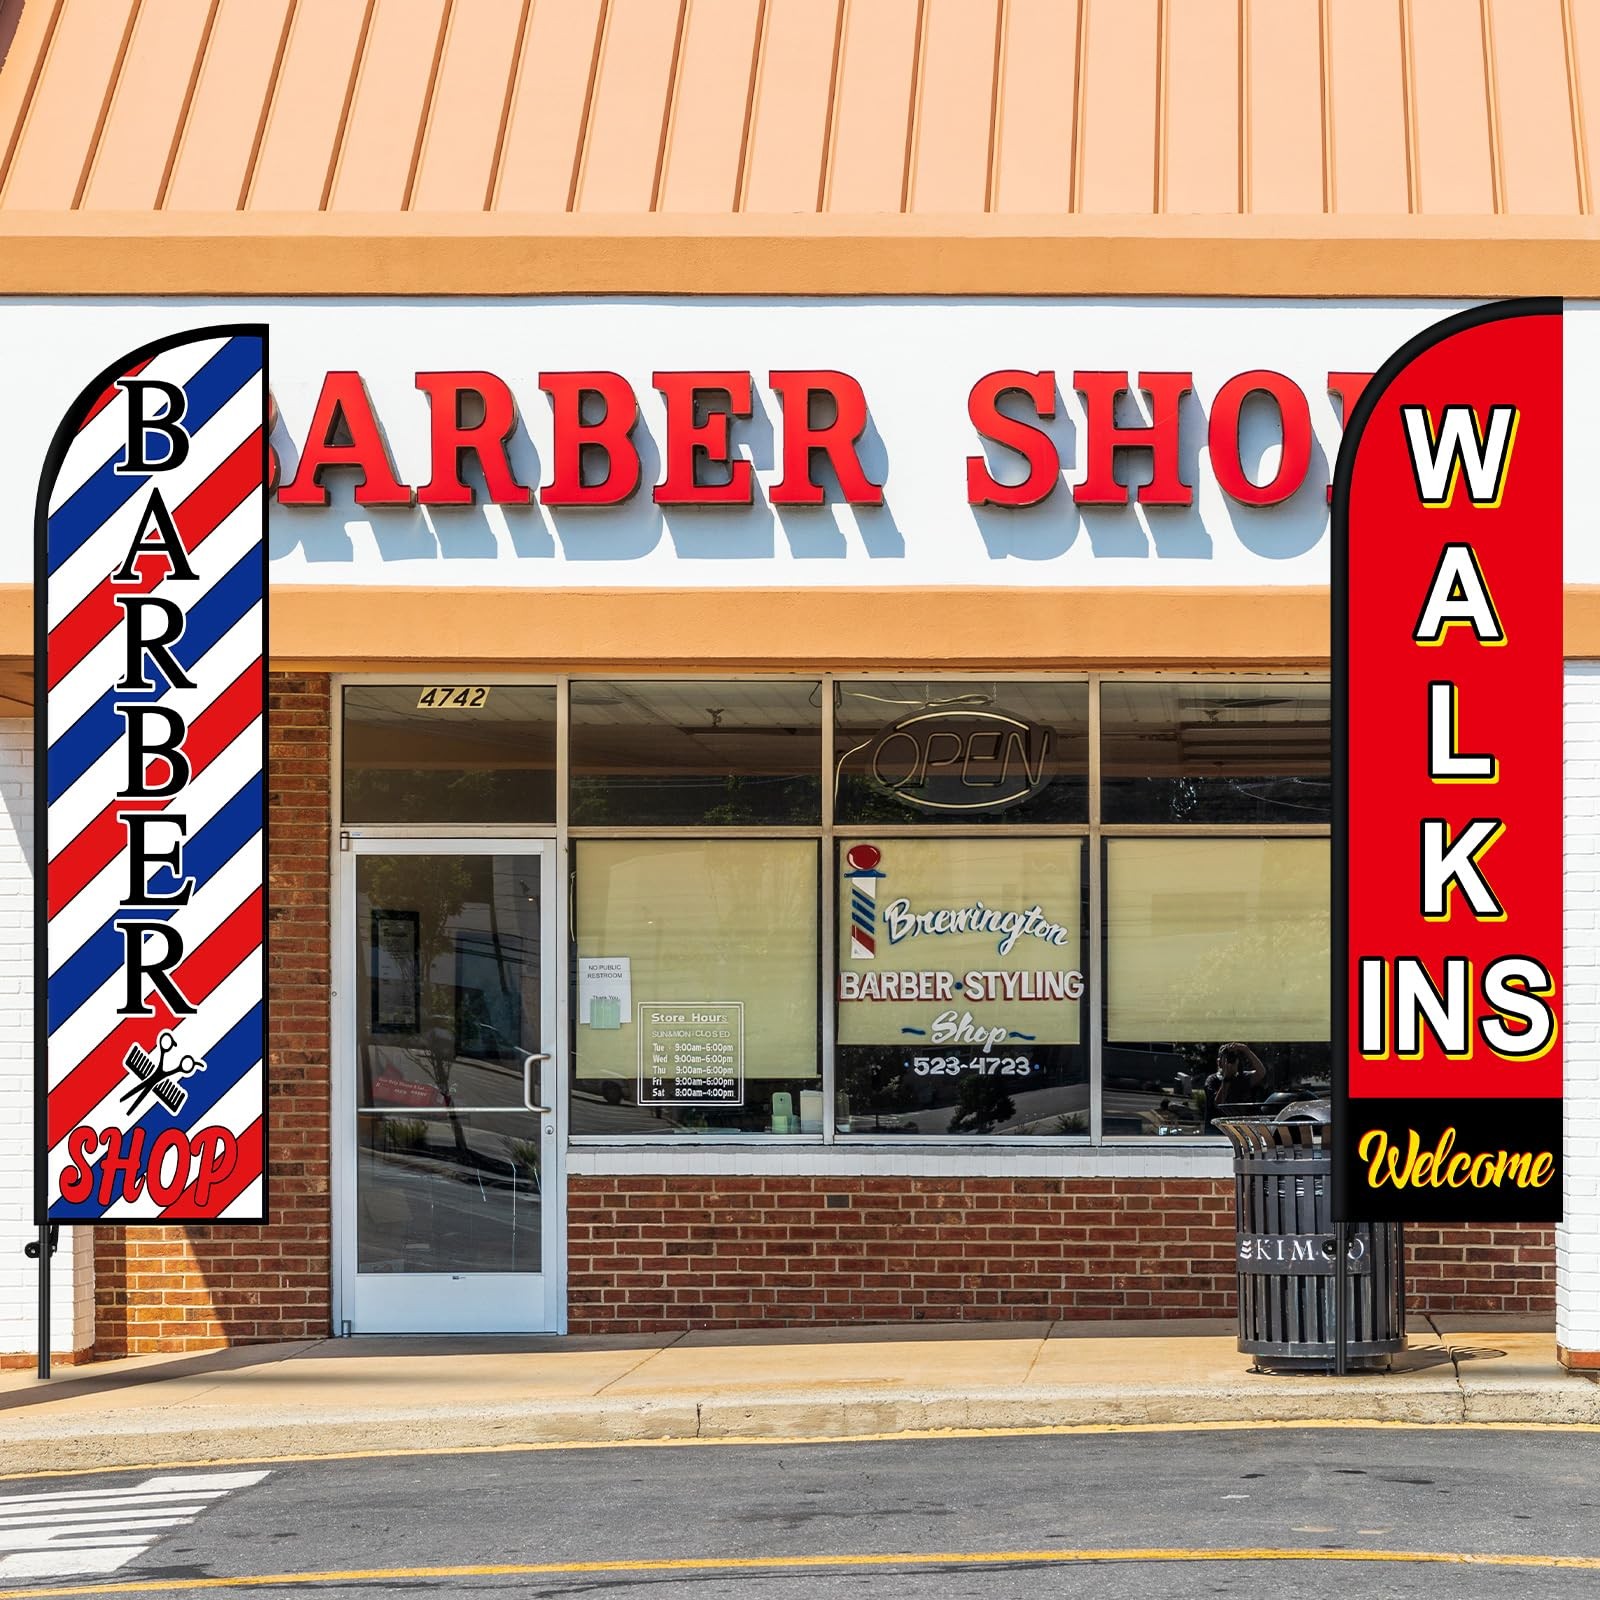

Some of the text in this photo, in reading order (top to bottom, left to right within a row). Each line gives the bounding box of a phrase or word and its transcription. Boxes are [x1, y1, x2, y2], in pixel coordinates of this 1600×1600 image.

[269, 370, 884, 507] ARBER
[1400, 404, 1521, 923] WALK
[112, 379, 199, 1014] BARBER
[420, 688, 486, 707] 4742
[872, 731, 1050, 789] OPEN
[883, 898, 1070, 956] Brewington
[651, 1012, 728, 1023] Store Hours
[1358, 955, 1559, 1062] INS
[653, 1043, 665, 1052] Tue
[930, 1010, 1008, 1054] Shop
[652, 1054, 668, 1063] Wed
[652, 1066, 666, 1074] Thu
[913, 1056, 1031, 1077] 523-4723
[652, 1077, 662, 1086] Fri
[652, 1088, 665, 1097] Sat
[59, 1125, 239, 1208] SHOP
[1357, 1126, 1556, 1190] Welcome
